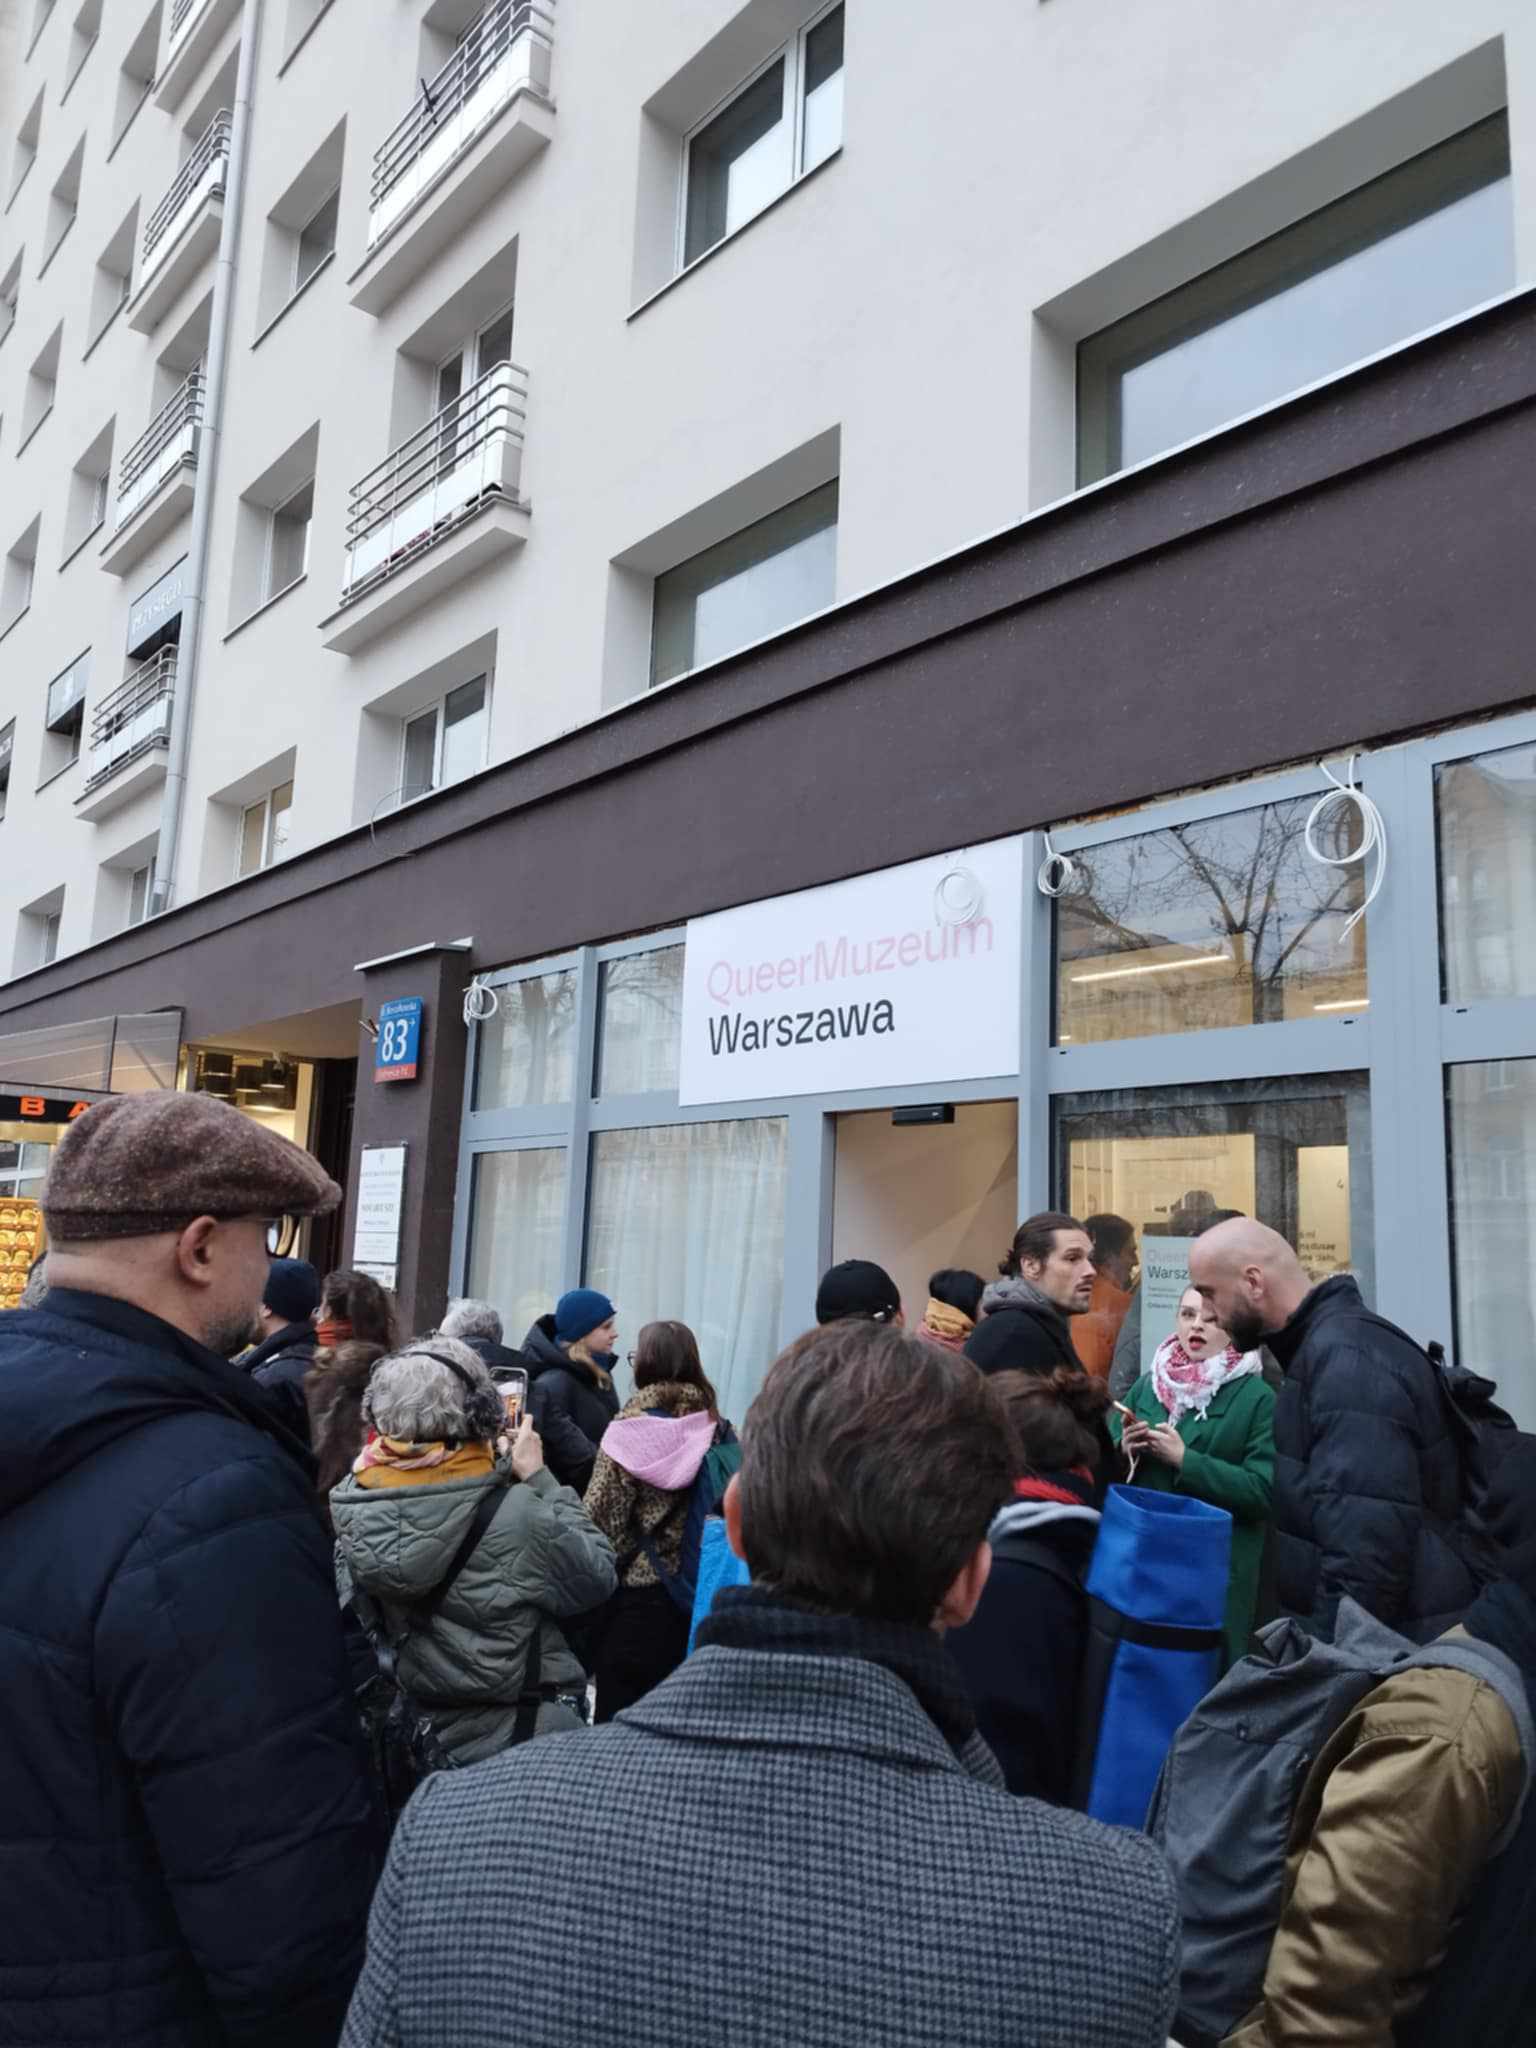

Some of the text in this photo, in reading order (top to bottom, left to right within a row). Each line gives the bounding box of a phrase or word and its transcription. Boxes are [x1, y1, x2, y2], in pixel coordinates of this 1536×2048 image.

[705, 916, 993, 1008] QueerMuzeum
[382, 1018, 408, 1062] 83
[709, 998, 895, 1056] Warszawa
[1147, 1265, 1190, 1280] Warsz
